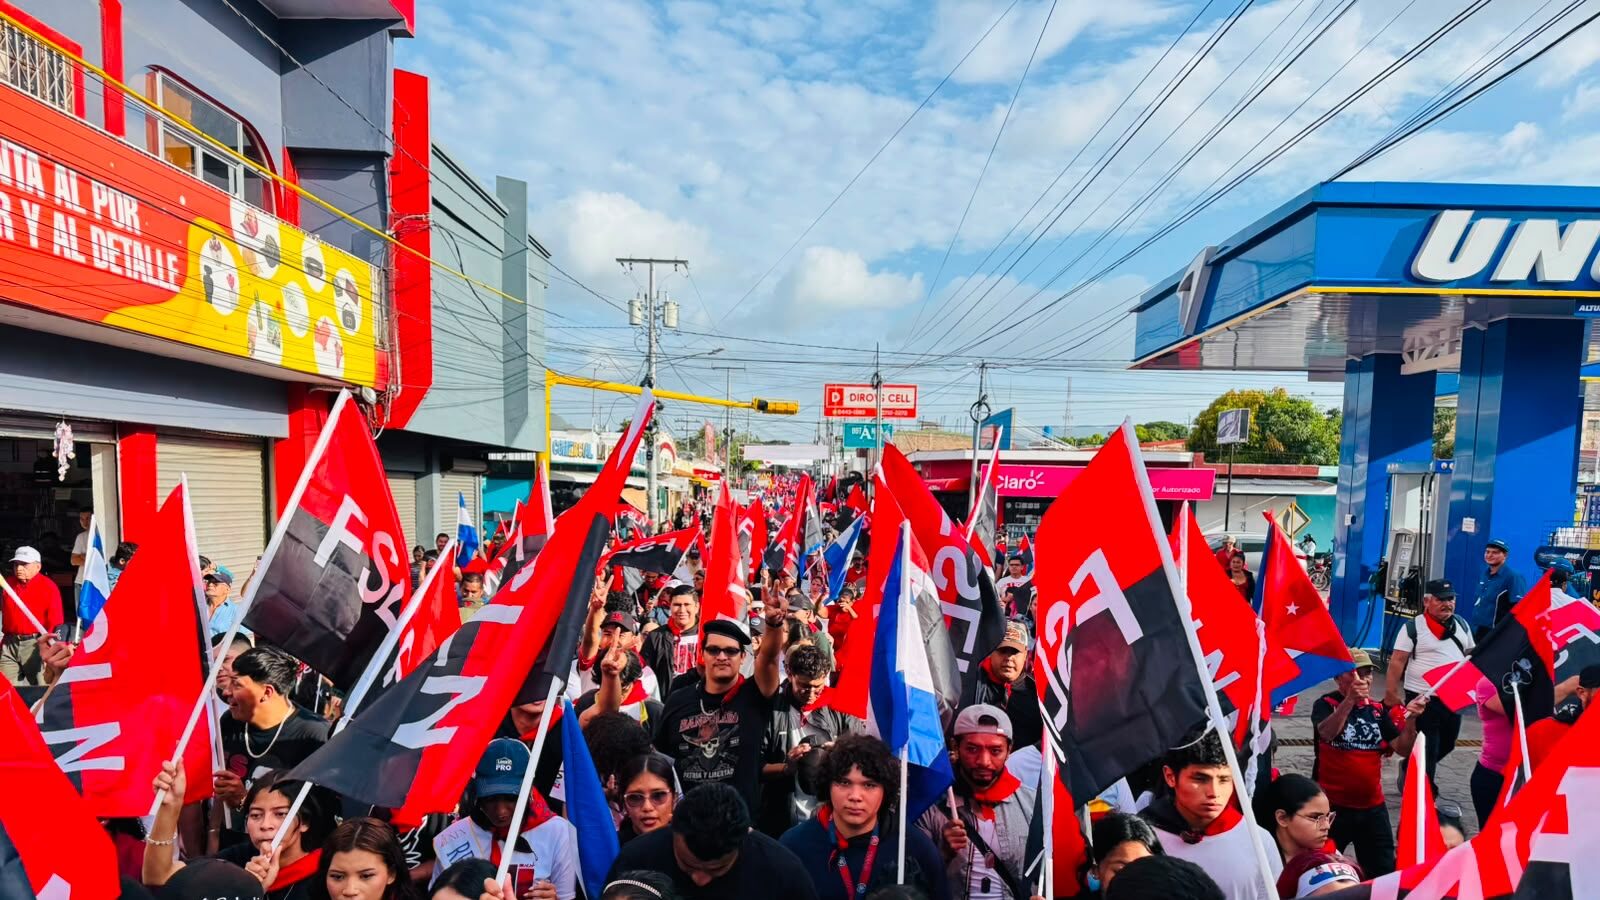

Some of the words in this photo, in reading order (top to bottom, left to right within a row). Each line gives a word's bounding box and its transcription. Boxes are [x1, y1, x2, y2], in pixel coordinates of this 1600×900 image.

[54, 162, 87, 215] AL
[20, 199, 40, 249] Y
[53, 211, 86, 265] AL
[90, 225, 181, 293] DETALLE
[1410, 208, 1600, 284] UN
[888, 393, 911, 404] CELL
[997, 473, 1037, 491] Claro
[1161, 485, 1201, 494] Autorizado
[708, 768, 735, 779] LIBERTAD
